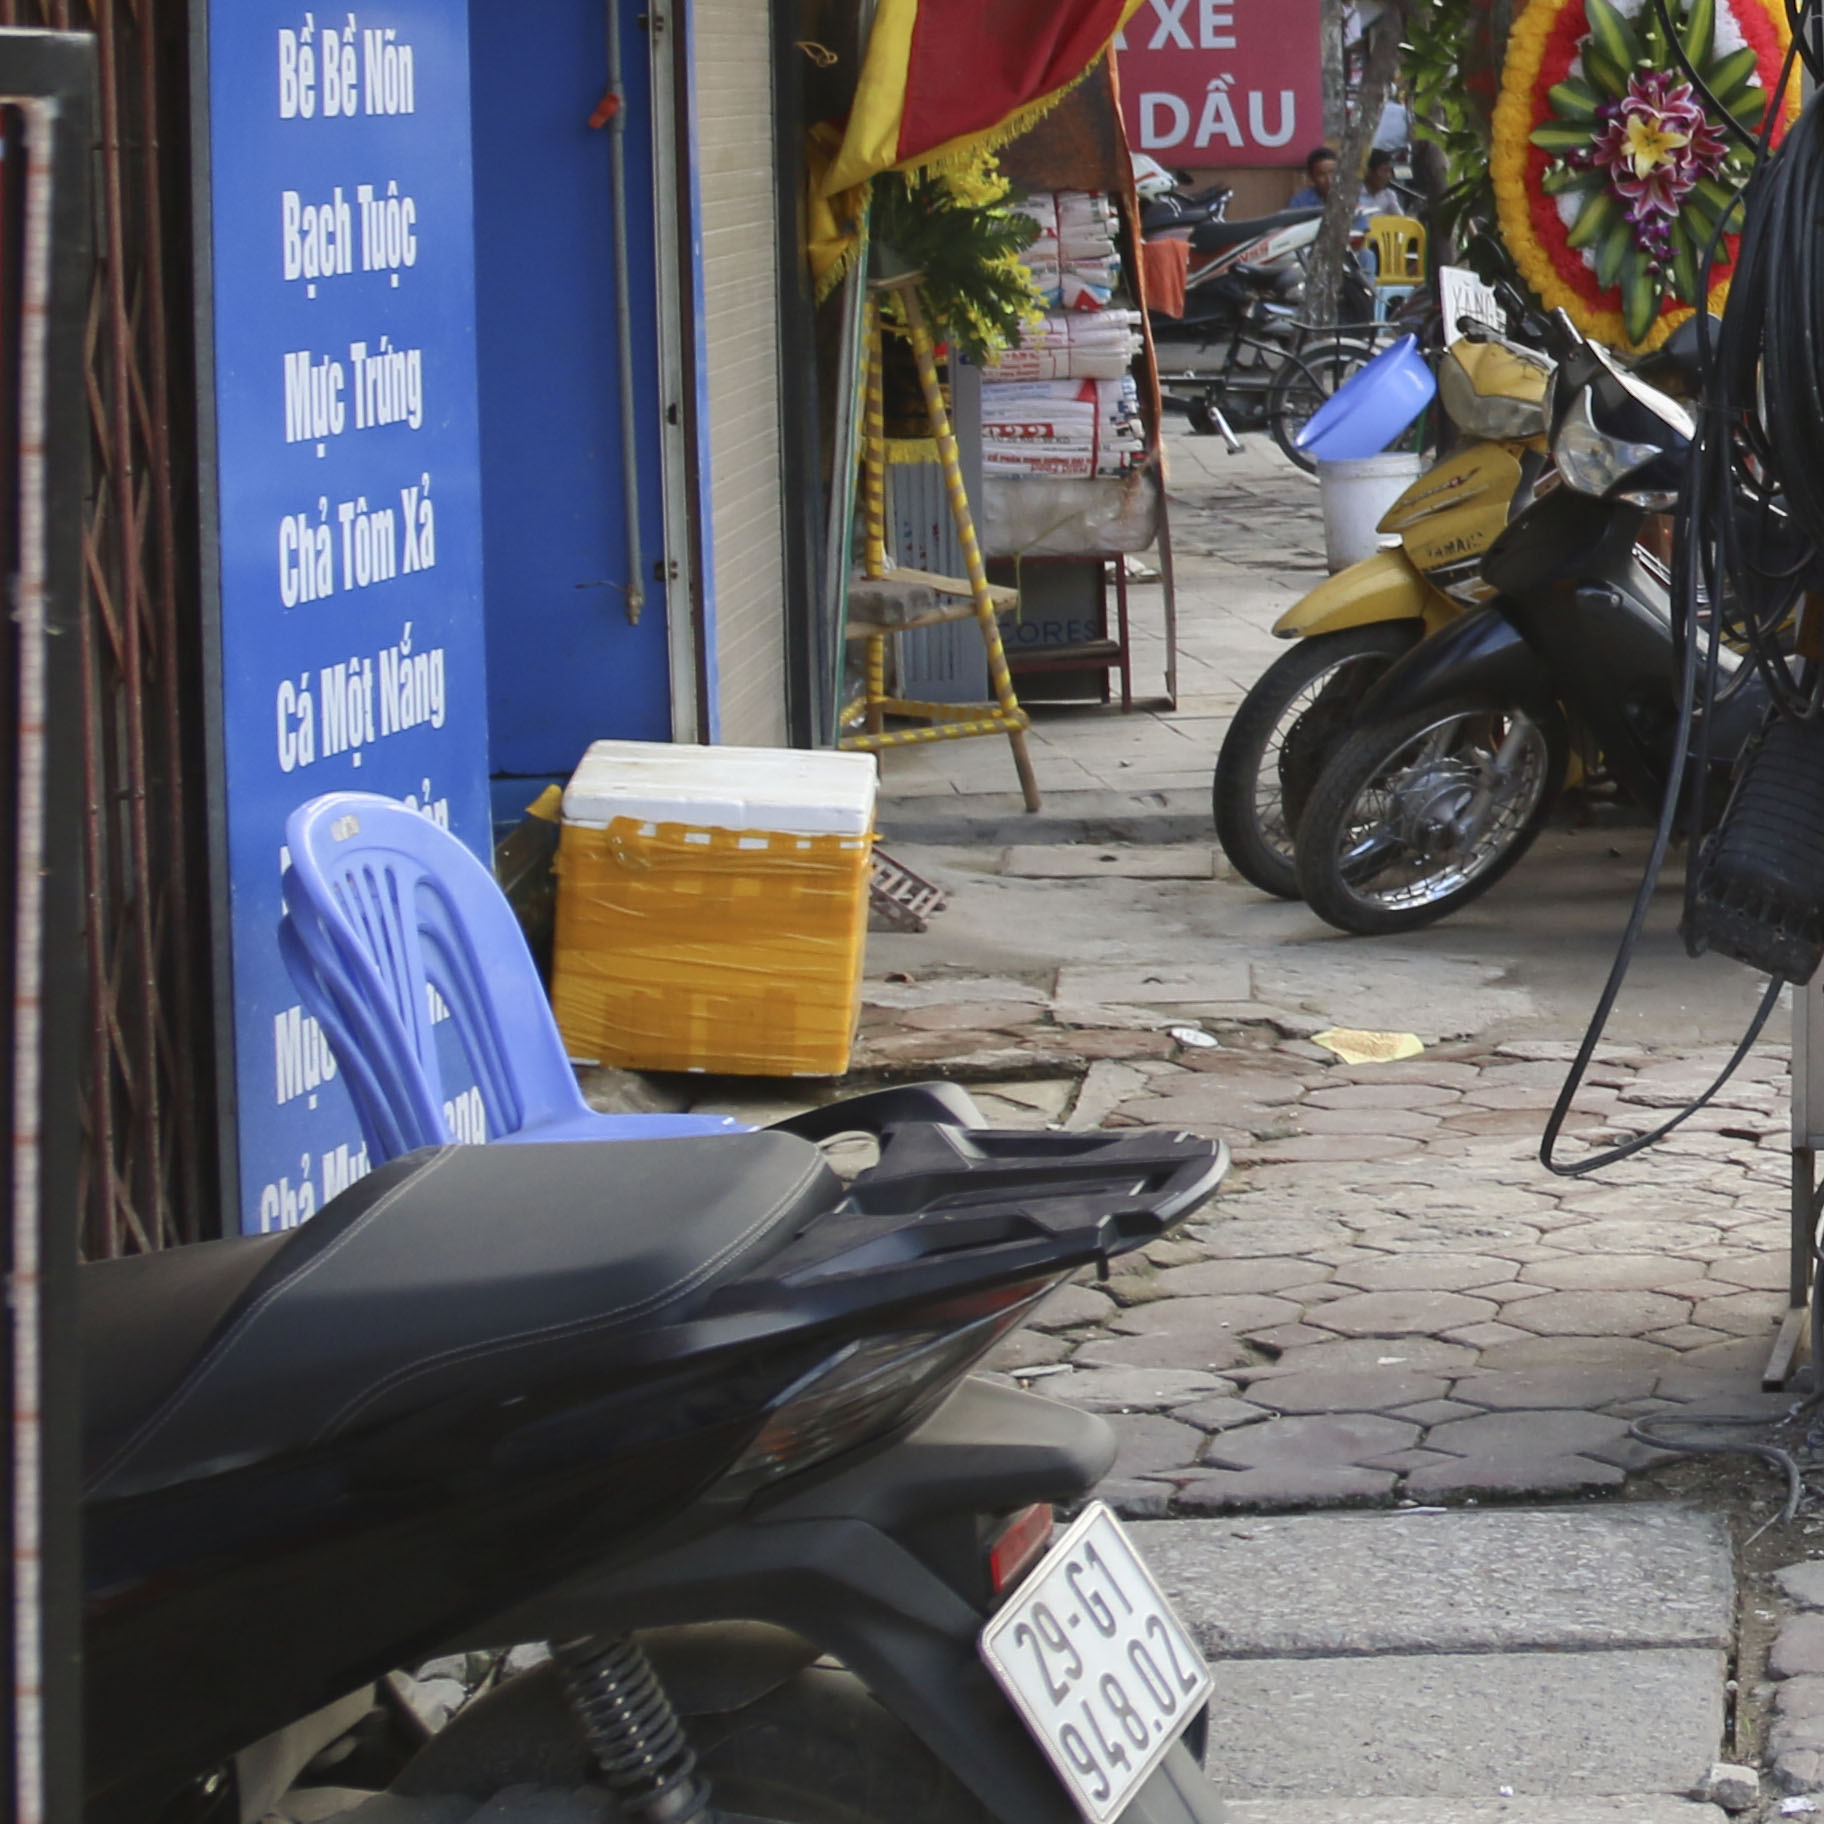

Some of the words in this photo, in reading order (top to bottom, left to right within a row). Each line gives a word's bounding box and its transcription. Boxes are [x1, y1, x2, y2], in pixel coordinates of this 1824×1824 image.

[278, 12, 316, 119] Bề
[322, 13, 357, 117] Bề
[364, 28, 414, 115] Nõn
[1140, 73, 1295, 150] DẦU
[282, 187, 352, 299] Bạch
[357, 180, 416, 288] Tuộc
[284, 351, 345, 458] Mực
[350, 336, 423, 430] Trứng
[279, 496, 333, 608] Chả
[339, 497, 396, 591] Tôm
[401, 472, 435, 574] Xả
[276, 672, 315, 773] Cá
[320, 657, 375, 768] Một
[379, 622, 445, 736] Nắng
[1012, 1539, 1134, 1708] 29-G1
[1059, 1614, 1198, 1802] 948.02
